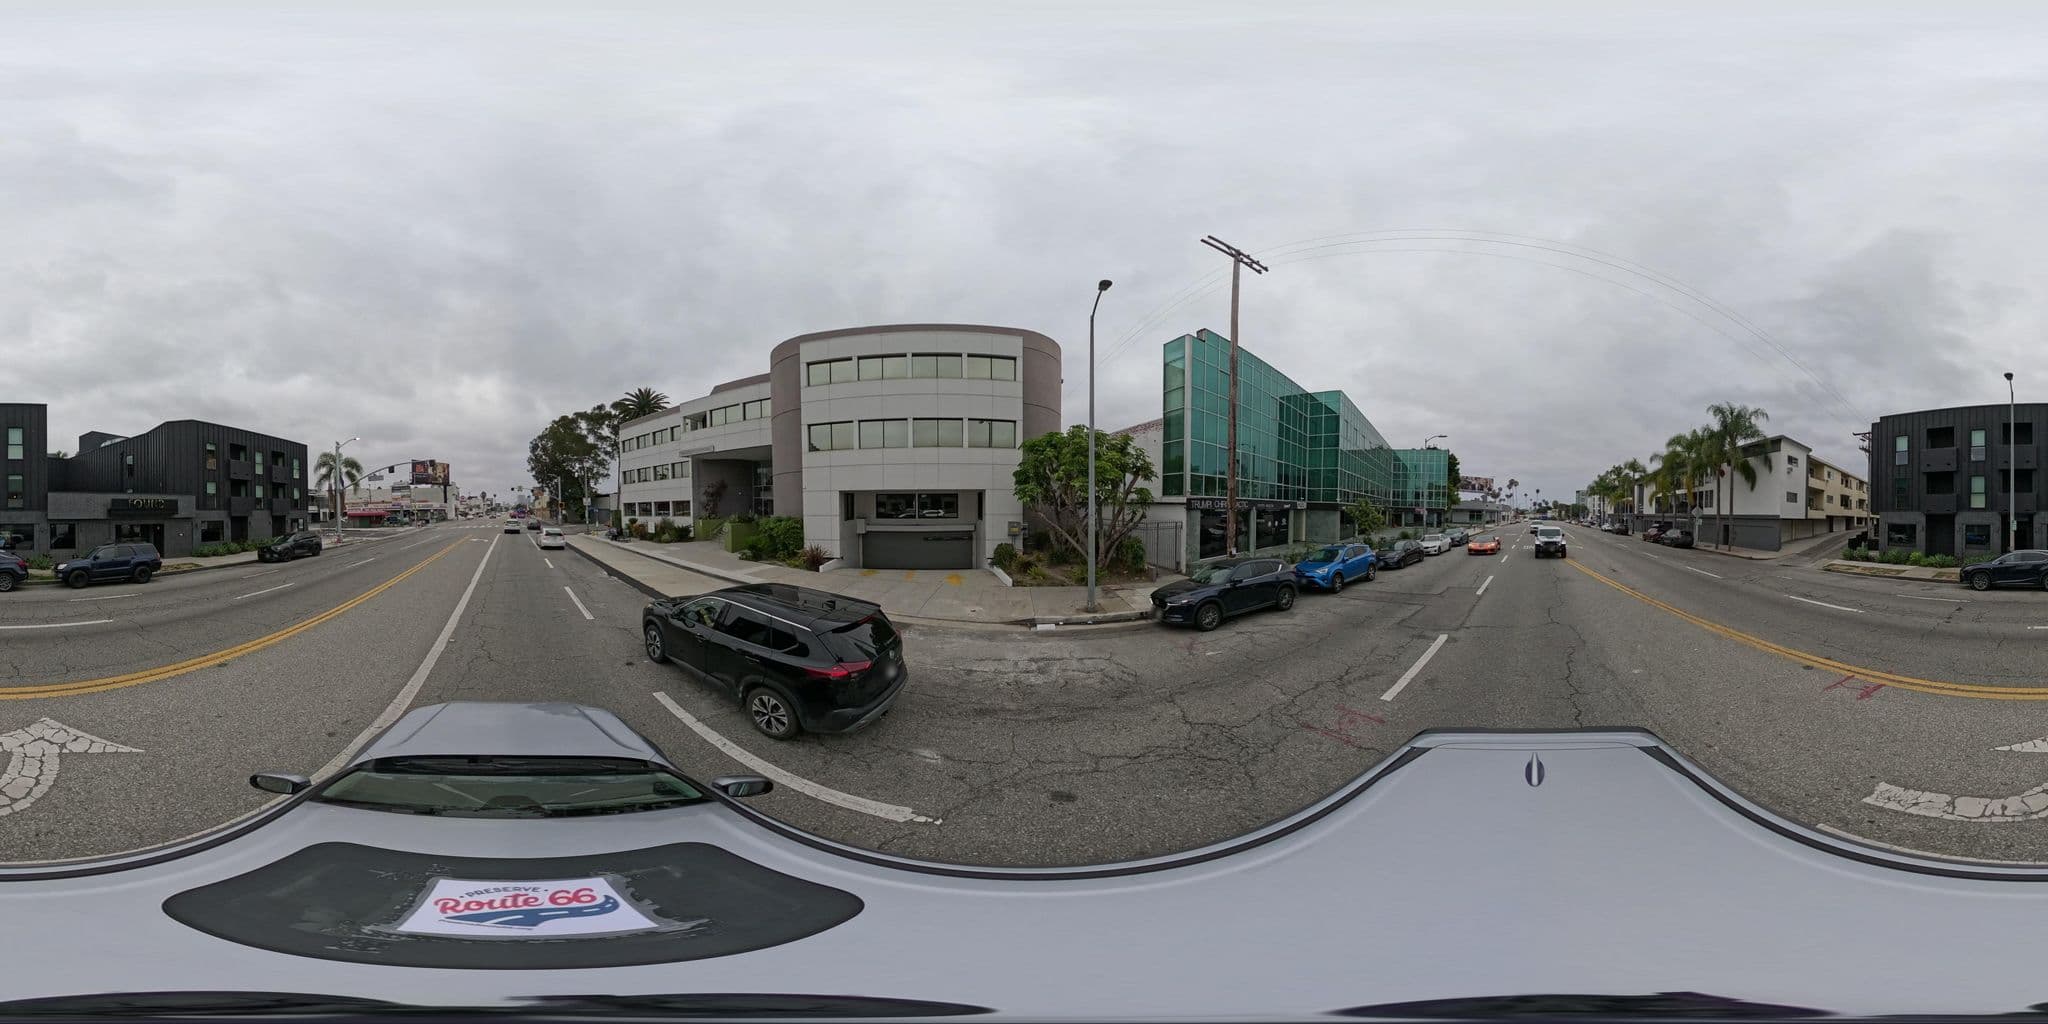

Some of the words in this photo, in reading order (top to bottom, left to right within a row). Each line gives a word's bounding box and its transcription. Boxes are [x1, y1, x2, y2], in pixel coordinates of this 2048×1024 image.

[434, 893, 545, 914] Route
[548, 887, 597, 906] 66
[465, 886, 540, 898] PRESERVE
